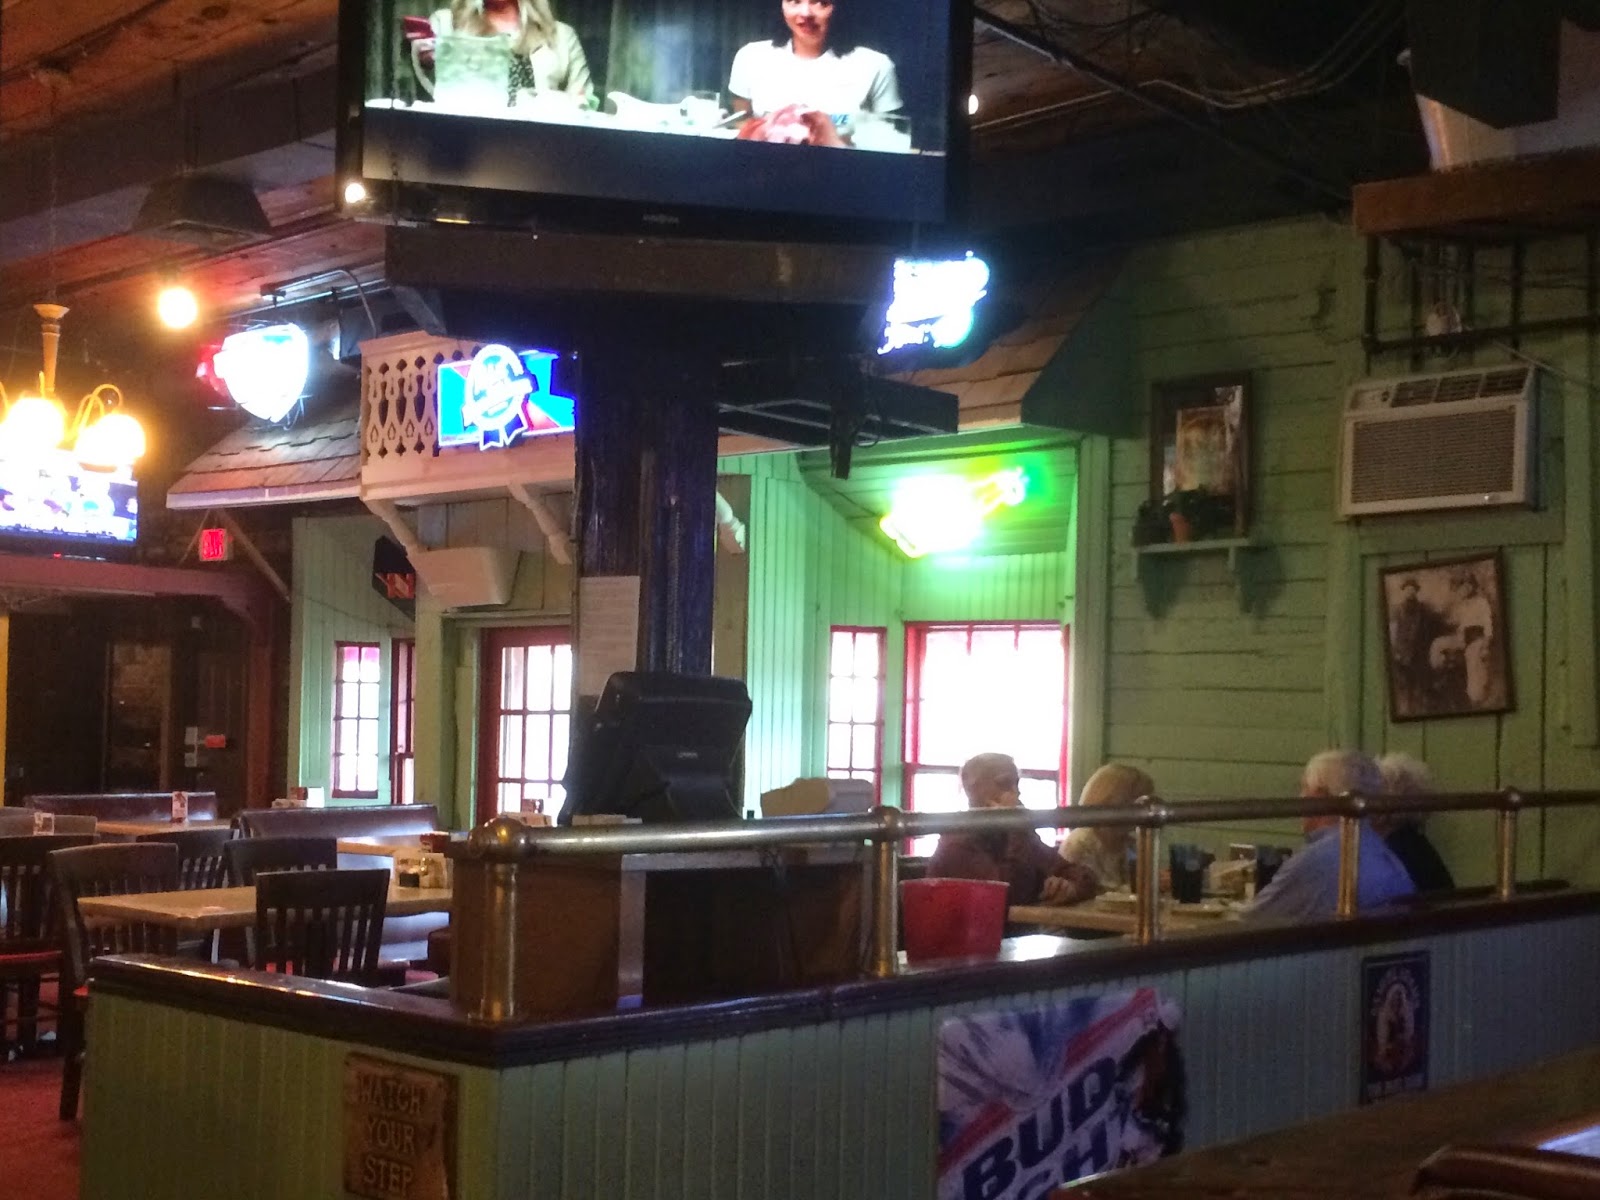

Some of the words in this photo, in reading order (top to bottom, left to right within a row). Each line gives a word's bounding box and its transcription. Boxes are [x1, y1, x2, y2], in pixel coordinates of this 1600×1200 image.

[358, 1073, 421, 1114] WATCH
[367, 1117, 415, 1154] YOUR
[962, 1056, 1117, 1200] BUD
[363, 1155, 414, 1197] STEP
